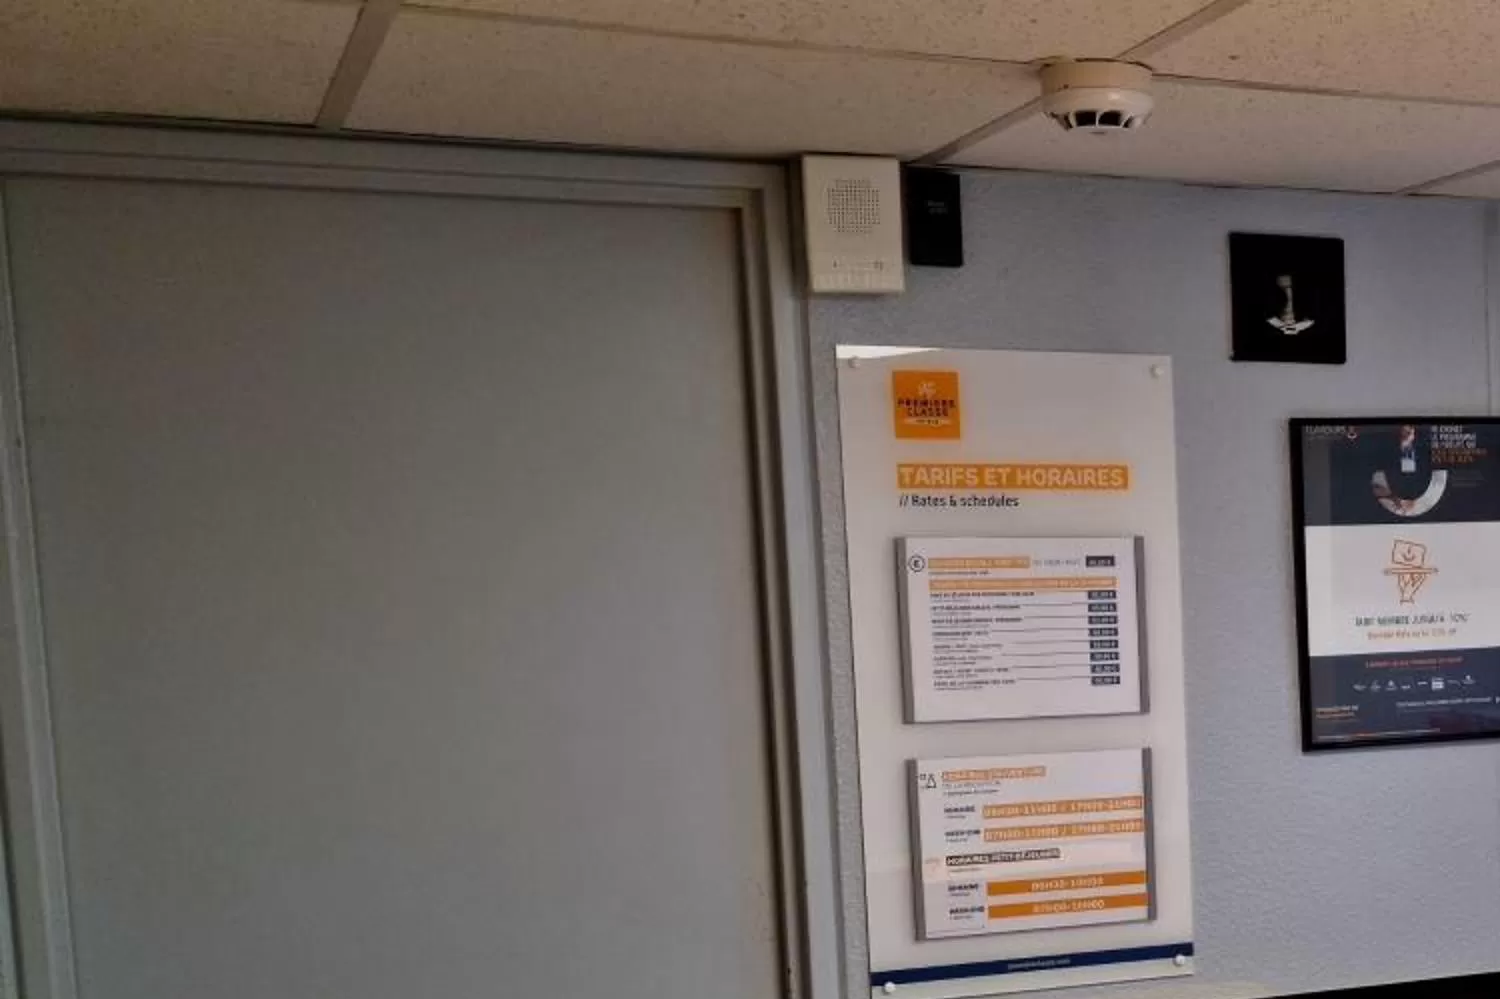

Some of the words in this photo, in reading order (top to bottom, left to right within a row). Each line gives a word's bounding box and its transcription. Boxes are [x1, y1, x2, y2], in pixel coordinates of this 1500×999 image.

[901, 467, 978, 486] TARIFS
[984, 467, 1010, 486] ET
[1017, 468, 1124, 487] HORAIRES
[912, 495, 947, 508] Rates
[960, 494, 1020, 508] schedules
